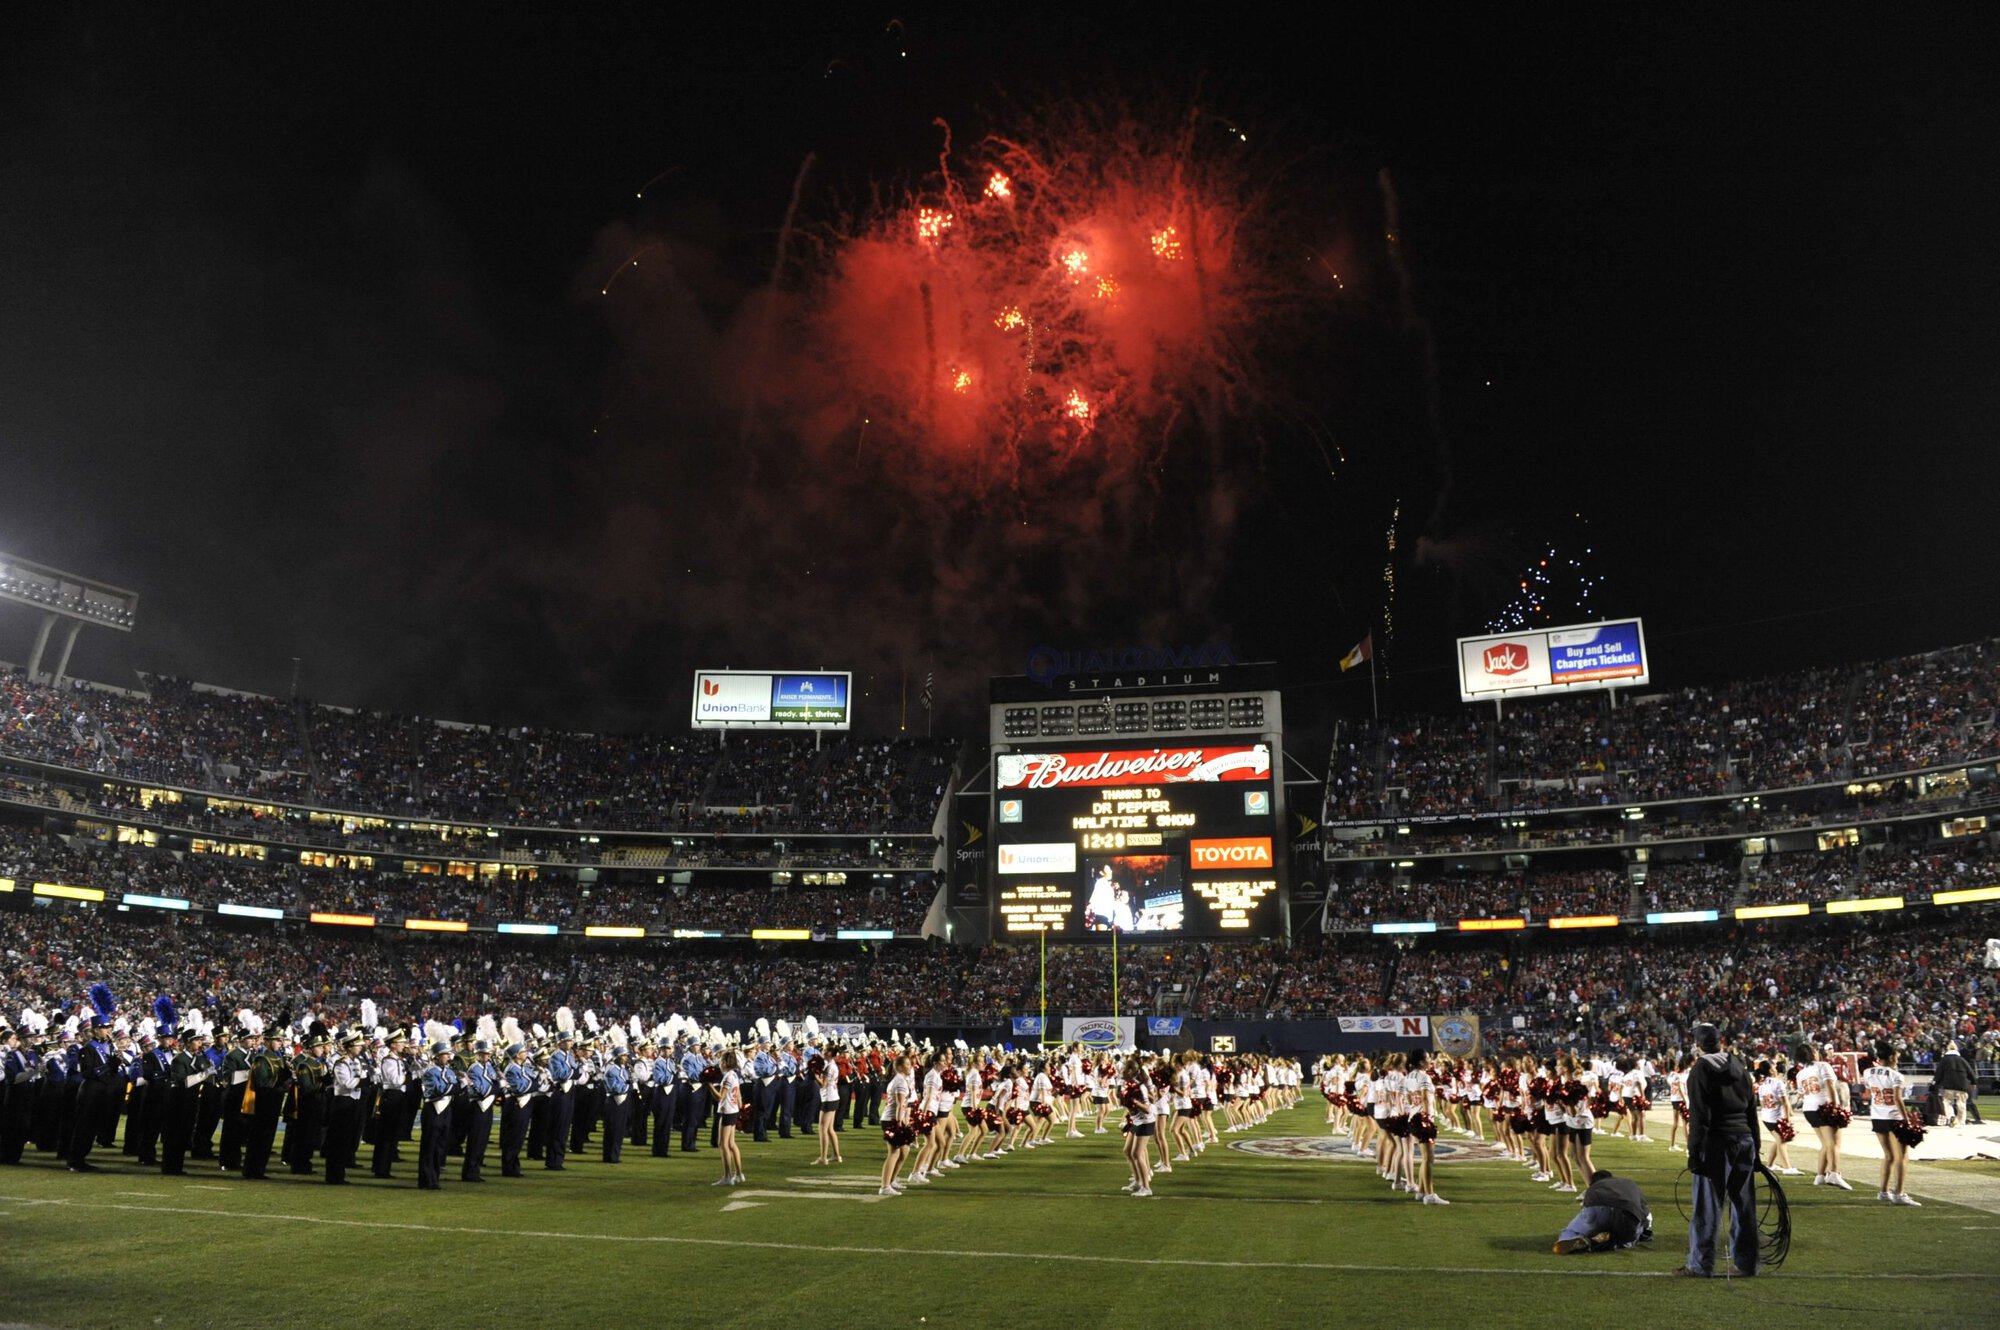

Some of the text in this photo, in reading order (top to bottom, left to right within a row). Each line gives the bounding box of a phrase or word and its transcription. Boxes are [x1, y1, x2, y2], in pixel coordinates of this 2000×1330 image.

[1567, 642, 1622, 658] Buy and Sell
[1025, 643, 1237, 688] QUALCOMM
[1486, 646, 1527, 672] Jack
[1556, 652, 1635, 670] Chargers Tickets!
[1069, 673, 1220, 688] STADIUM
[702, 704, 766, 712] UnionBank
[775, 710, 798, 718] ready.
[815, 710, 842, 718] thrive.
[1024, 749, 1202, 789] Budweiser
[1102, 788, 1161, 800] THANKS TO
[1093, 801, 1170, 814] DR PEPPER
[1073, 814, 1196, 829] HALFTIME SHOW
[956, 849, 984, 860] Sprint
[1194, 846, 1269, 862] TOYOTA
[1402, 1018, 1421, 1035] N
[1214, 1037, 1232, 1052] 25
